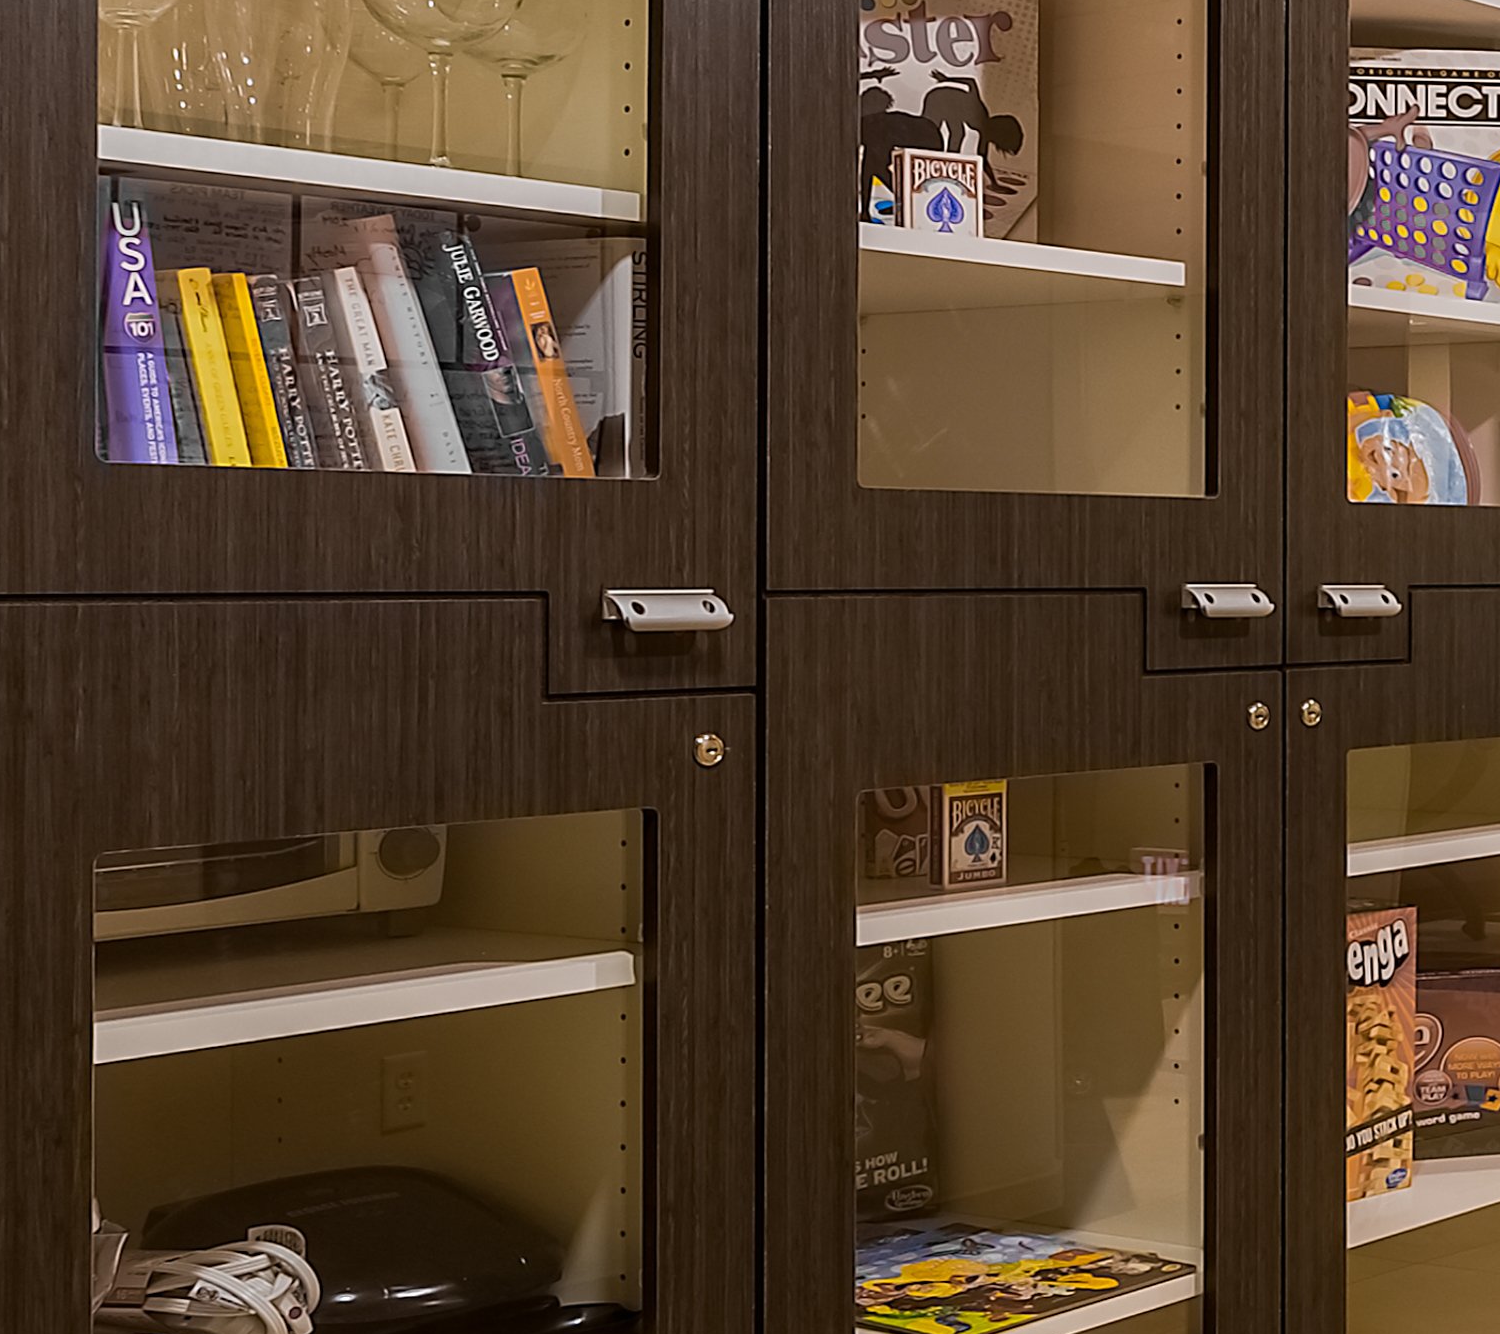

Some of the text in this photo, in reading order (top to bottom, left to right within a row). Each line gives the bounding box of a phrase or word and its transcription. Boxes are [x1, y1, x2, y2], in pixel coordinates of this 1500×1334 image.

[860, 0, 1012, 67] ster
[1357, 67, 1432, 78] ORIGINAL
[1439, 70, 1479, 79] GAME
[912, 157, 976, 193] BICYCLE
[110, 200, 154, 307] USA
[441, 243, 500, 361] JULIE GARWOOD
[344, 278, 376, 366] THE GREAT MAN
[147, 360, 158, 385] GUIDE
[151, 386, 159, 398] TO
[278, 348, 315, 467] HARRY POTTE
[325, 350, 350, 411] HARRY
[343, 416, 363, 470] POTTE
[552, 378, 585, 472] North Country Mom
[145, 422, 156, 440] AND
[382, 414, 396, 440] KATE
[952, 797, 1001, 833] BICYCLE
[957, 869, 997, 881] JUMBO
[1347, 919, 1410, 986] enga
[1420, 1084, 1447, 1094] TEAM
[1416, 1110, 1481, 1127] word game
[1357, 1125, 1373, 1147] YOU
[855, 1172, 869, 1190] E
[873, 1157, 928, 1186] ROLL!
[865, 1151, 898, 1171] HOW
